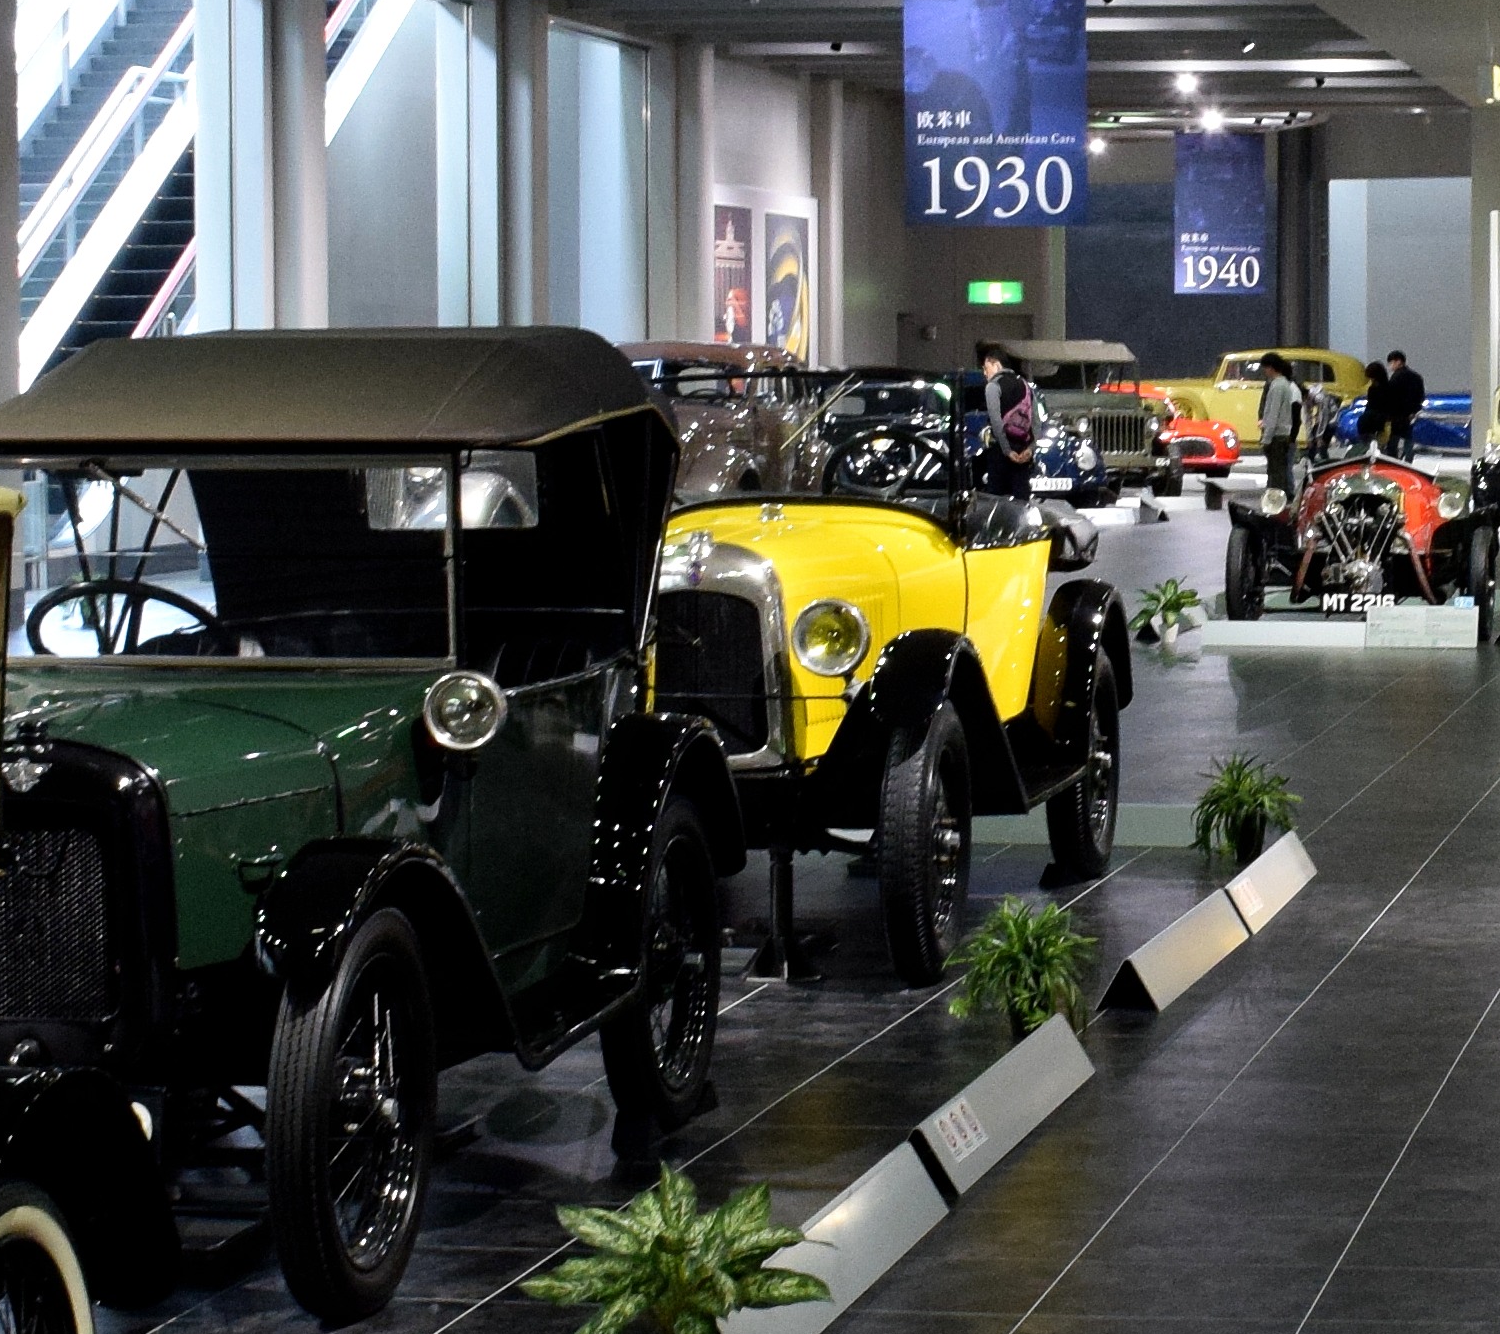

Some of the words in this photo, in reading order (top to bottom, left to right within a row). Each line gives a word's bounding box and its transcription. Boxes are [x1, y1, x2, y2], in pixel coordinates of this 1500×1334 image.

[917, 134, 969, 148] European
[973, 134, 993, 145] and
[996, 133, 1047, 145] American
[1050, 133, 1076, 145] Cars
[923, 155, 1073, 219] 1930
[1183, 253, 1260, 290] 1940
[1323, 593, 1348, 612] MT
[1350, 593, 1396, 612] 2216
